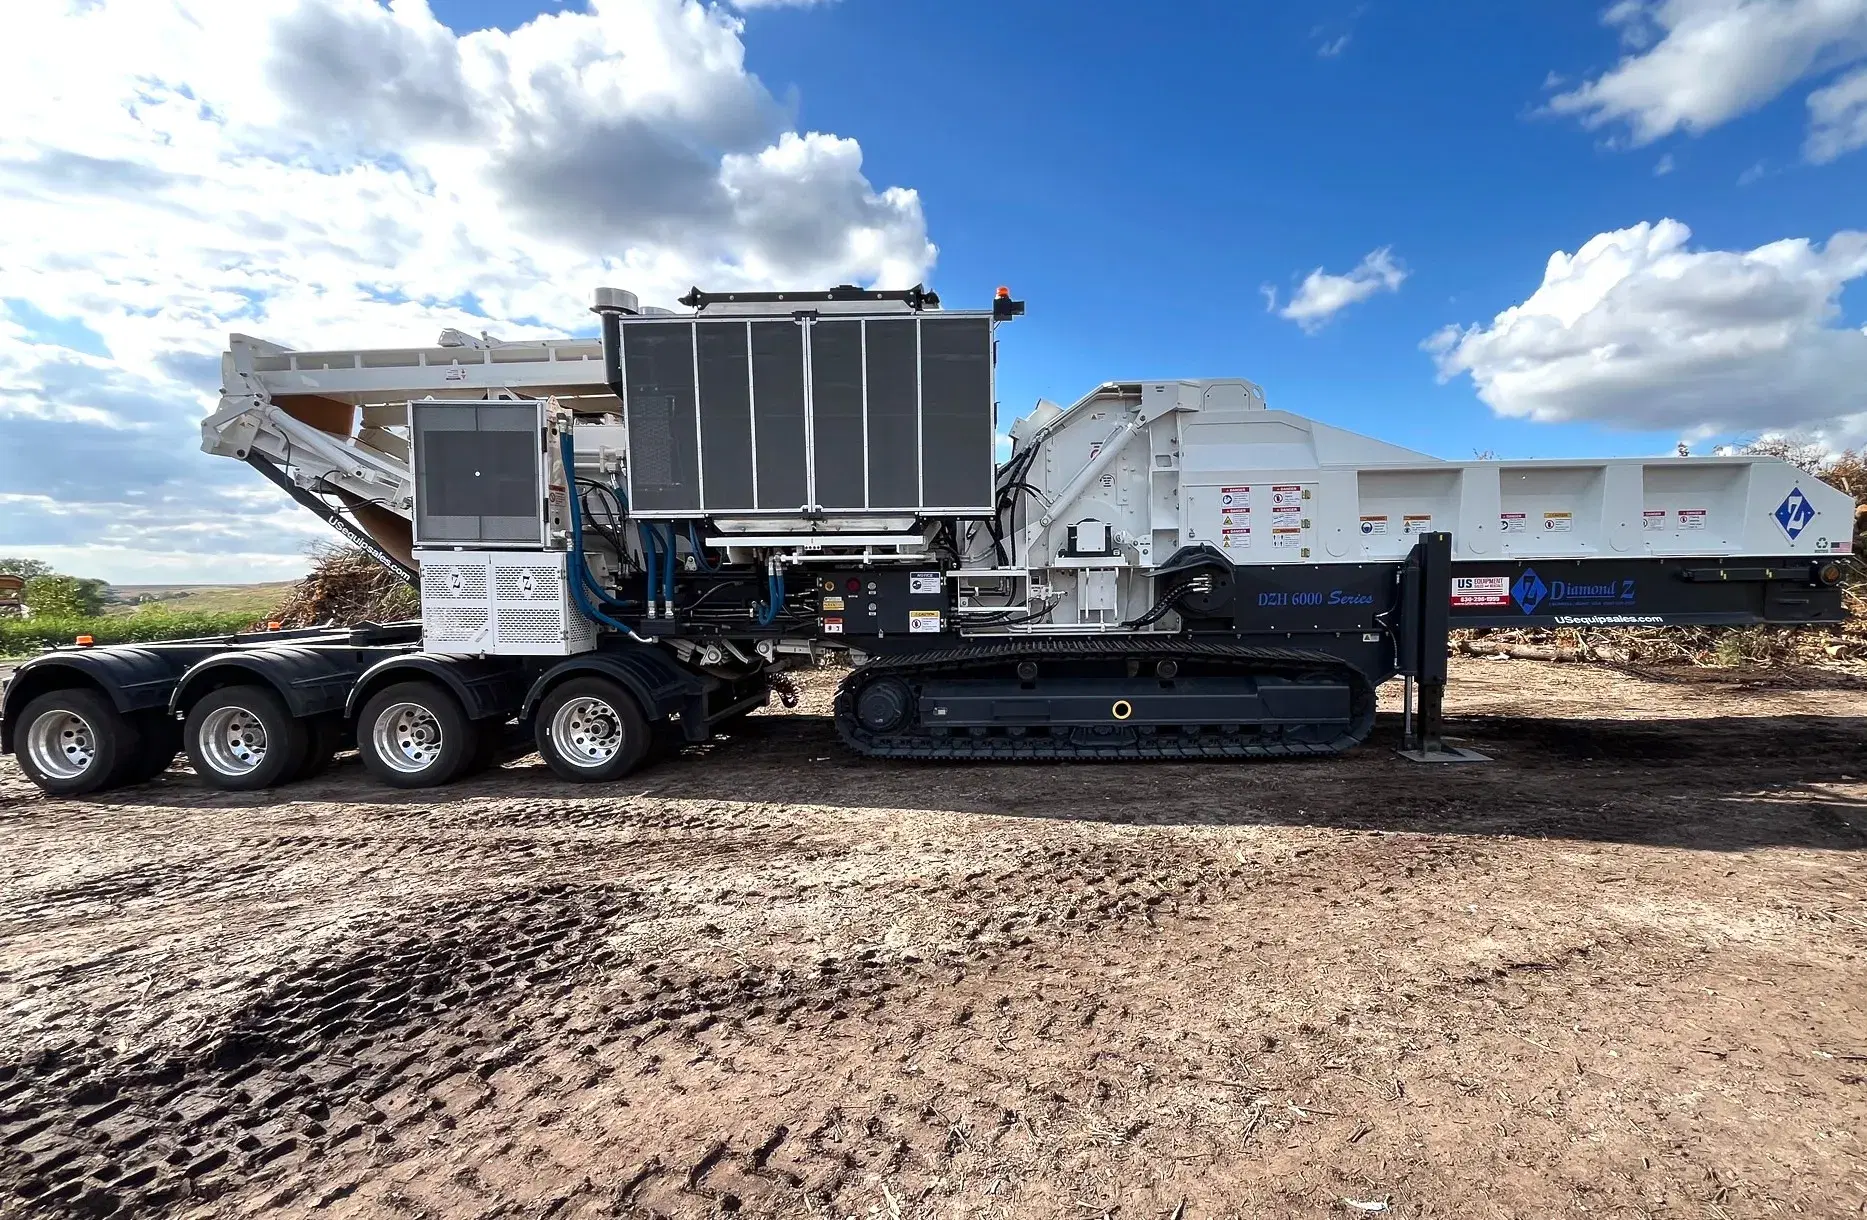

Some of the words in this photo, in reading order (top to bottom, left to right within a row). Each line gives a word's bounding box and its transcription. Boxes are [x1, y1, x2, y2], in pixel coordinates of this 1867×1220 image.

[1787, 496, 1804, 532] Z
[328, 515, 411, 581] USequipsales.com
[1457, 579, 1473, 588] US
[1550, 580, 1616, 600] Diamond
[1620, 580, 1635, 599] Z
[1258, 593, 1288, 606] DZH
[1291, 592, 1323, 605] 6000
[1327, 590, 1373, 605] Series
[1554, 615, 1664, 625] USequipsales.com
